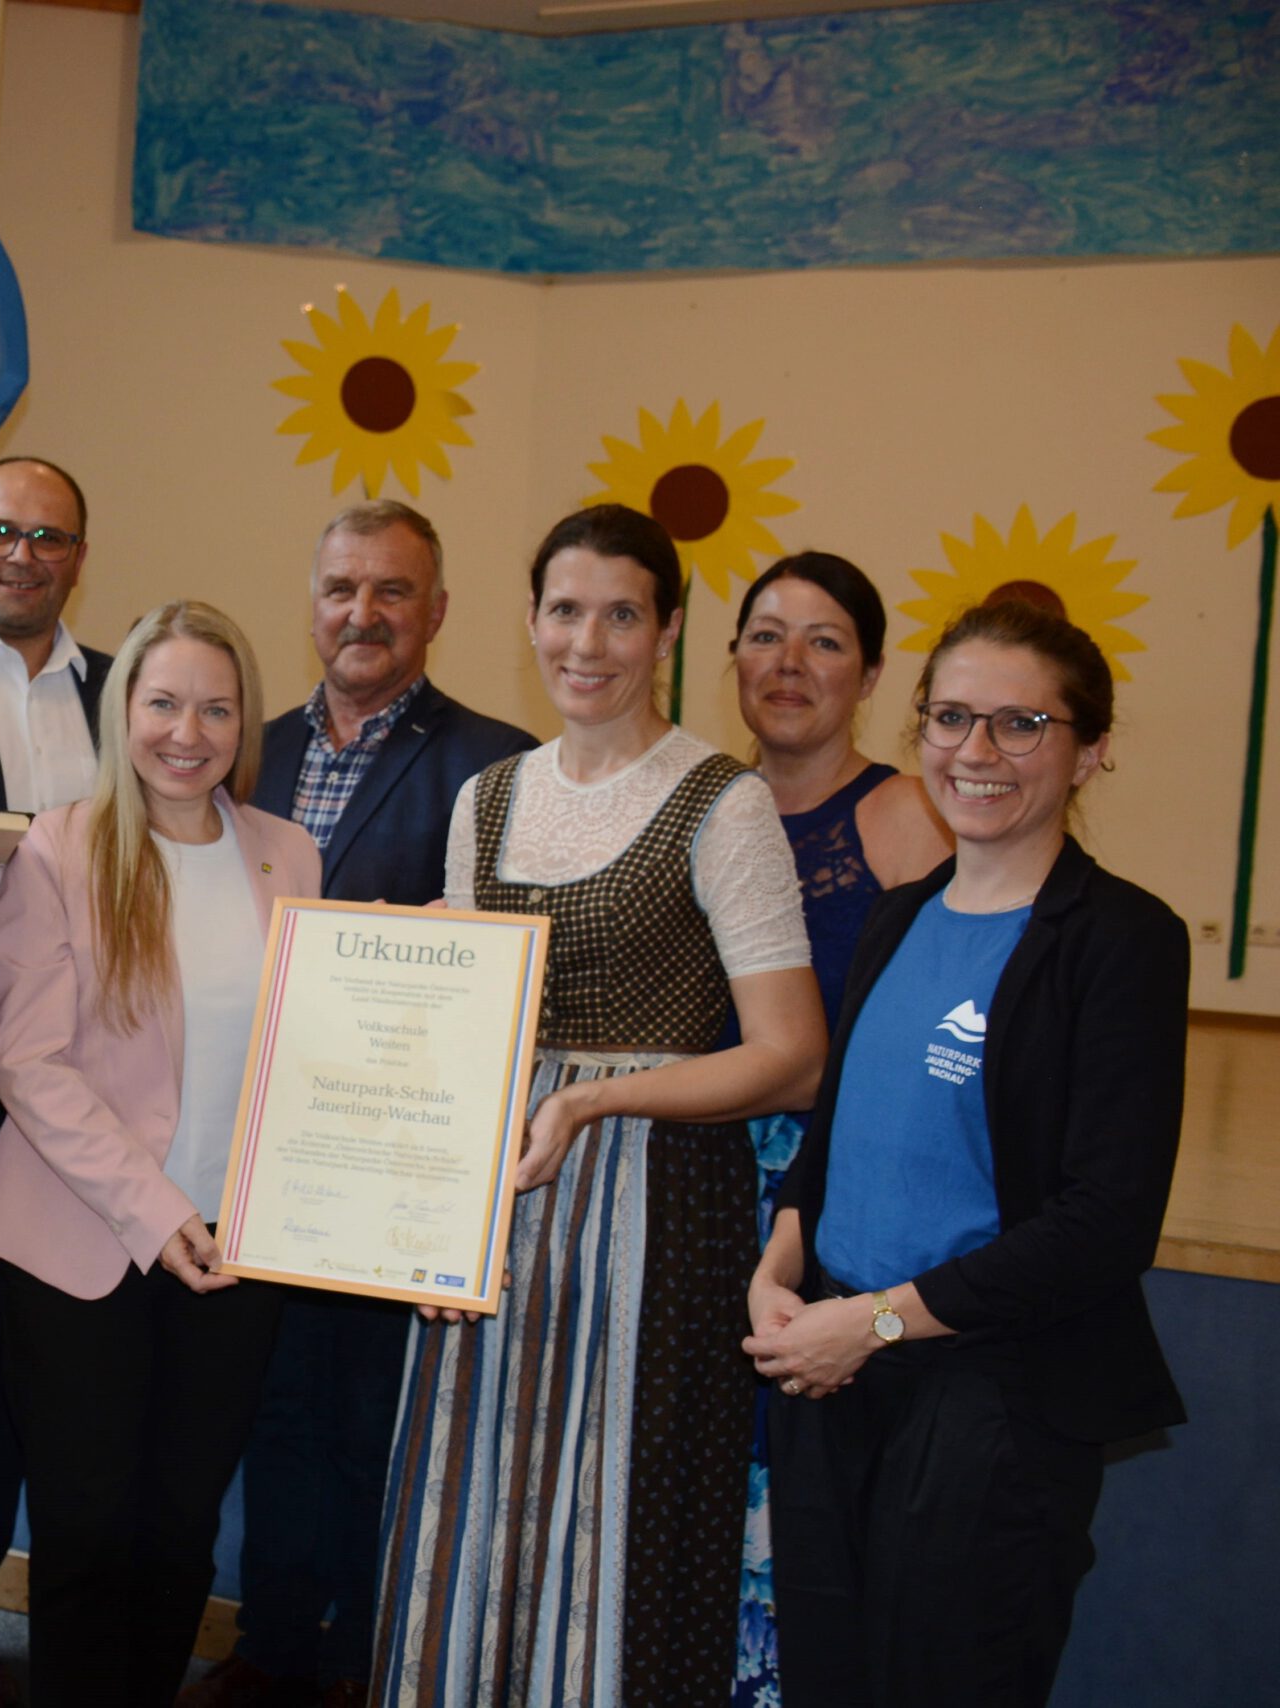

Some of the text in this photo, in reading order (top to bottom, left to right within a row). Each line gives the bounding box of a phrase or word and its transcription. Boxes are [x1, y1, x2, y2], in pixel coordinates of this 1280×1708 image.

[336, 931, 476, 969] Urkunde
[357, 1019, 429, 1037] Volksschule
[370, 1037, 411, 1052] Weiten
[926, 1043, 982, 1069] NATURPARK
[927, 1066, 966, 1085] WACHAU
[312, 1075, 455, 1105] Naturpark-Schule
[307, 1096, 452, 1126] Jauerling-Wachau
